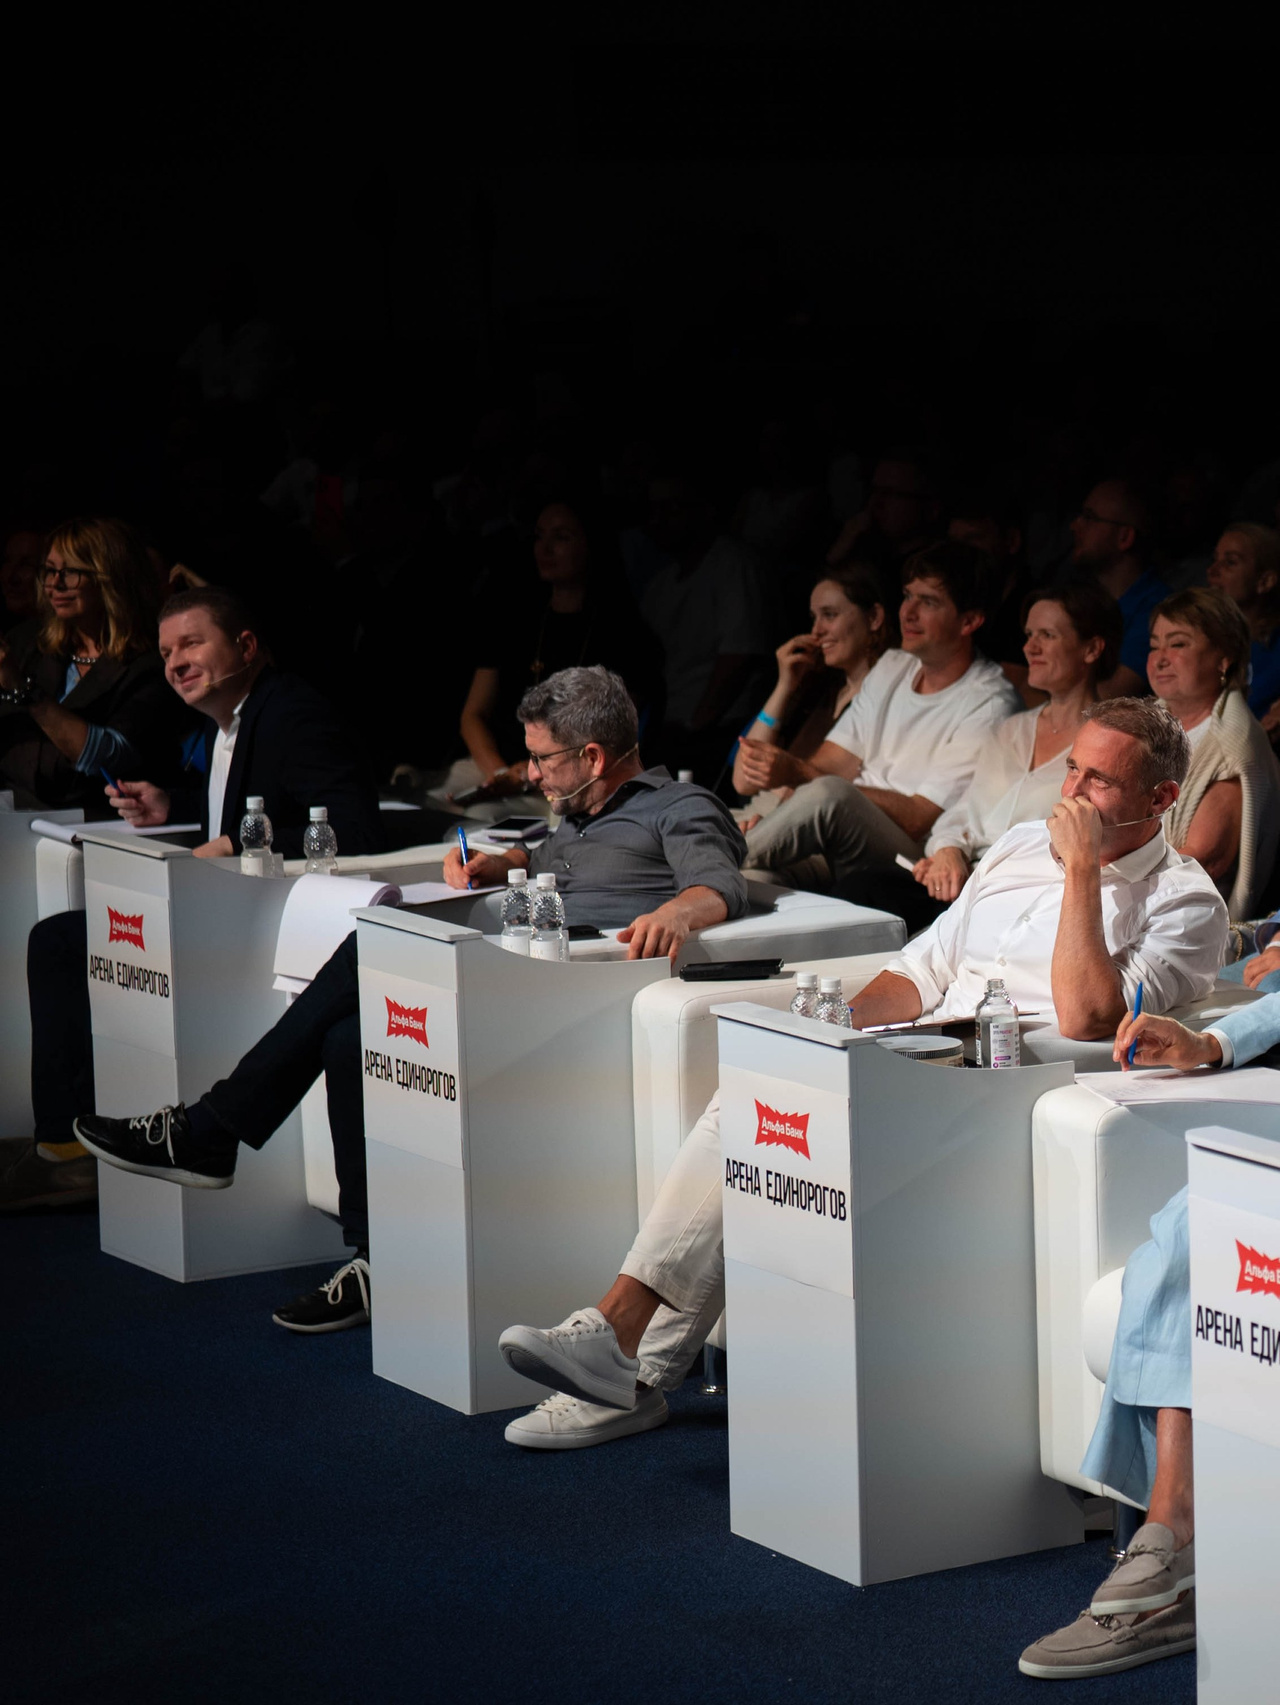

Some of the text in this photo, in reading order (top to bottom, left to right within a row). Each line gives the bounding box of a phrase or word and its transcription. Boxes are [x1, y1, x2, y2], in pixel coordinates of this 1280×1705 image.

[89, 955, 170, 998] АРЕНА ЕДИНОРОГОВ
[390, 1010, 424, 1031] Альфа Банк
[364, 1048, 457, 1102] АРЕНА ЕДИНОРОГОВ
[761, 1116, 805, 1140] Альфа Банк
[725, 1157, 847, 1221] АРЕНА ЕДИНОРОГОВ
[1244, 1259, 1275, 1285] Альфа
[1195, 1304, 1244, 1353] АРЕНА
